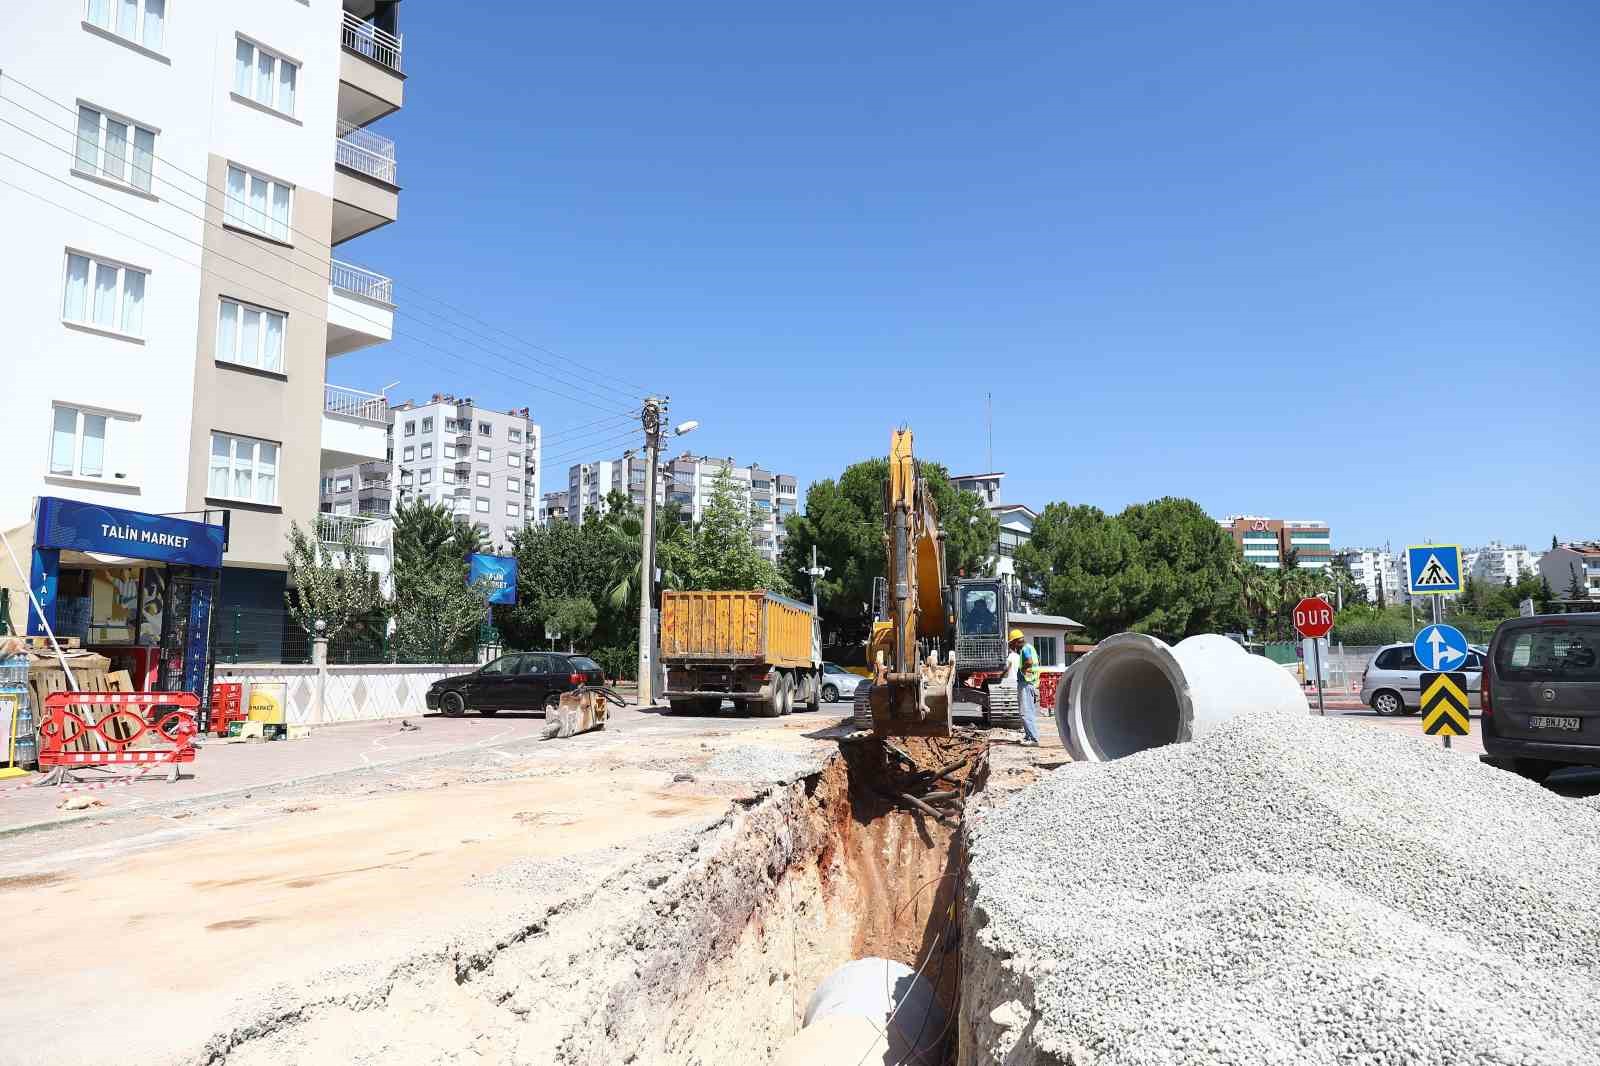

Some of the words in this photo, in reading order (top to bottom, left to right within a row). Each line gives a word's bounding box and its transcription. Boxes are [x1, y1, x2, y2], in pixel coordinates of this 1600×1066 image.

[101, 524, 138, 541] TALİN
[141, 530, 189, 548] MARKET
[1297, 609, 1330, 627] DUR
